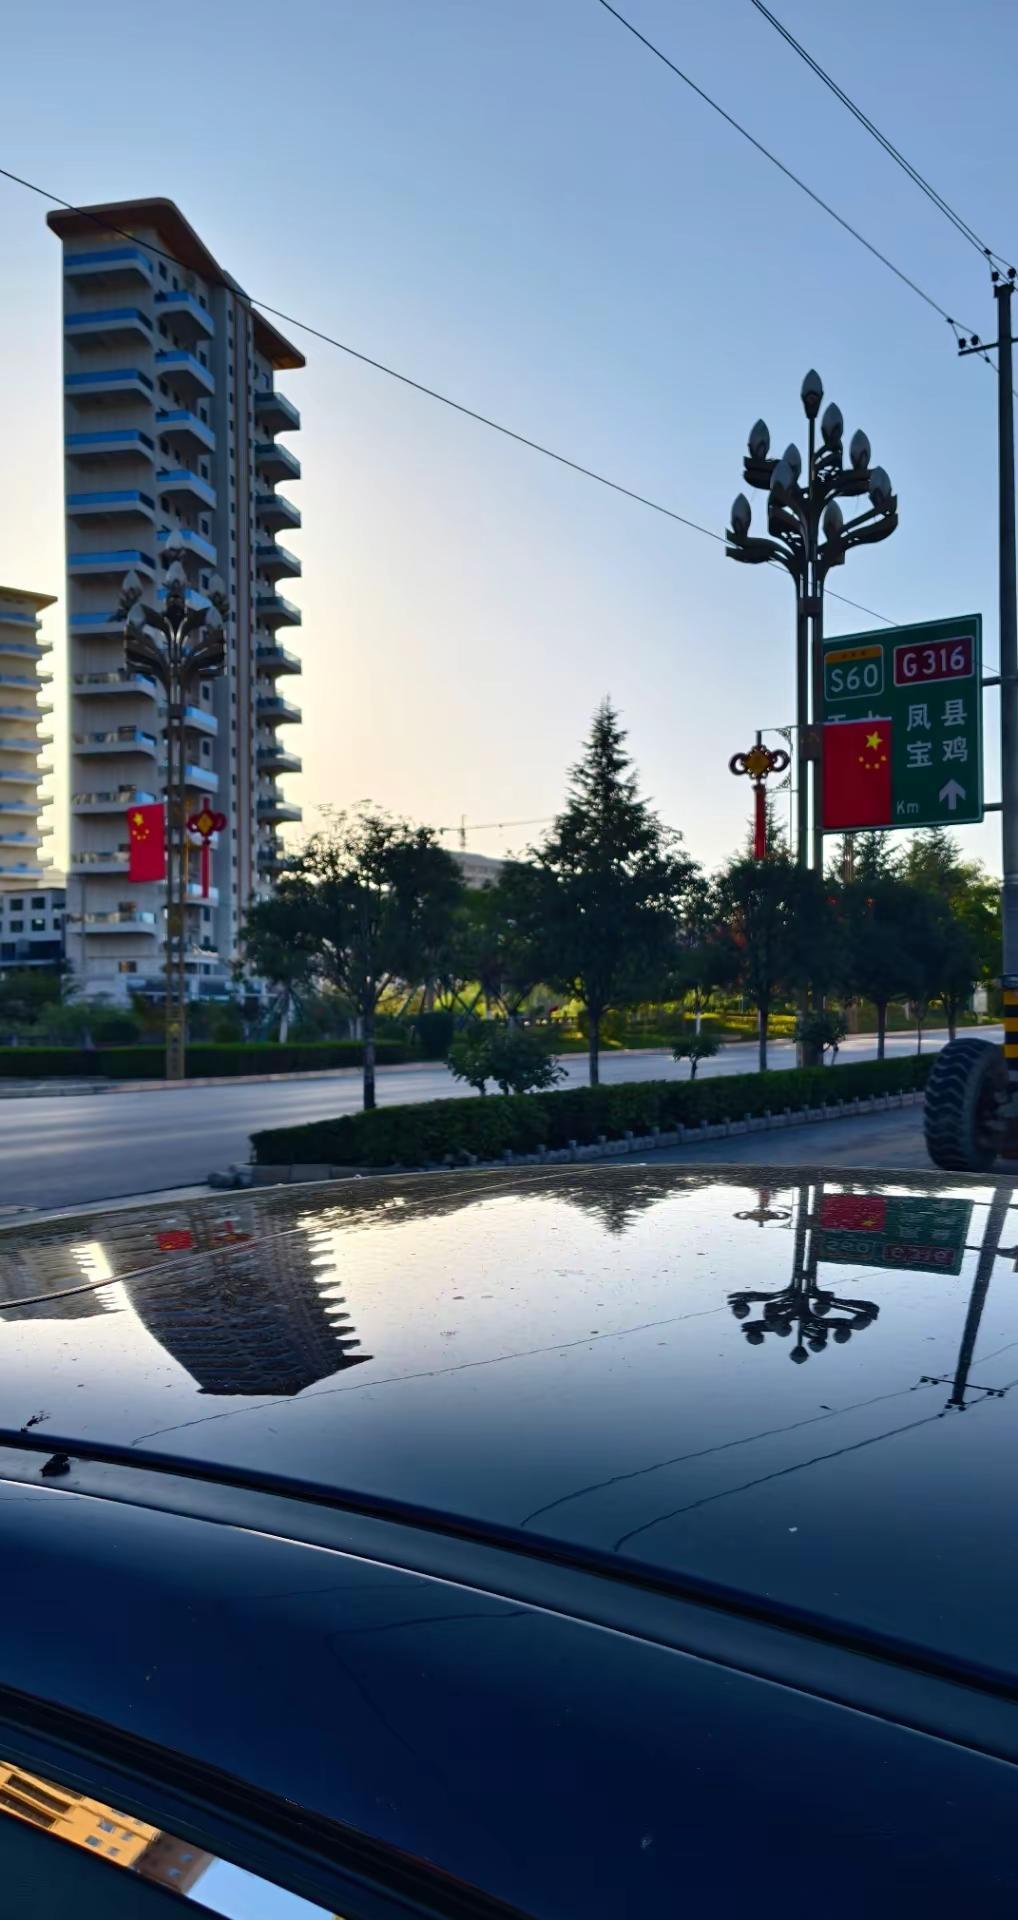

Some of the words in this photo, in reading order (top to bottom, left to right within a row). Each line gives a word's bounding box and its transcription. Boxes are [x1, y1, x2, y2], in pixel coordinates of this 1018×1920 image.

[902, 646, 965, 677] G316
[830, 663, 878, 692] S60
[906, 698, 968, 732] 凤县
[906, 736, 968, 768] 宝鸡
[896, 799, 920, 815] Km
